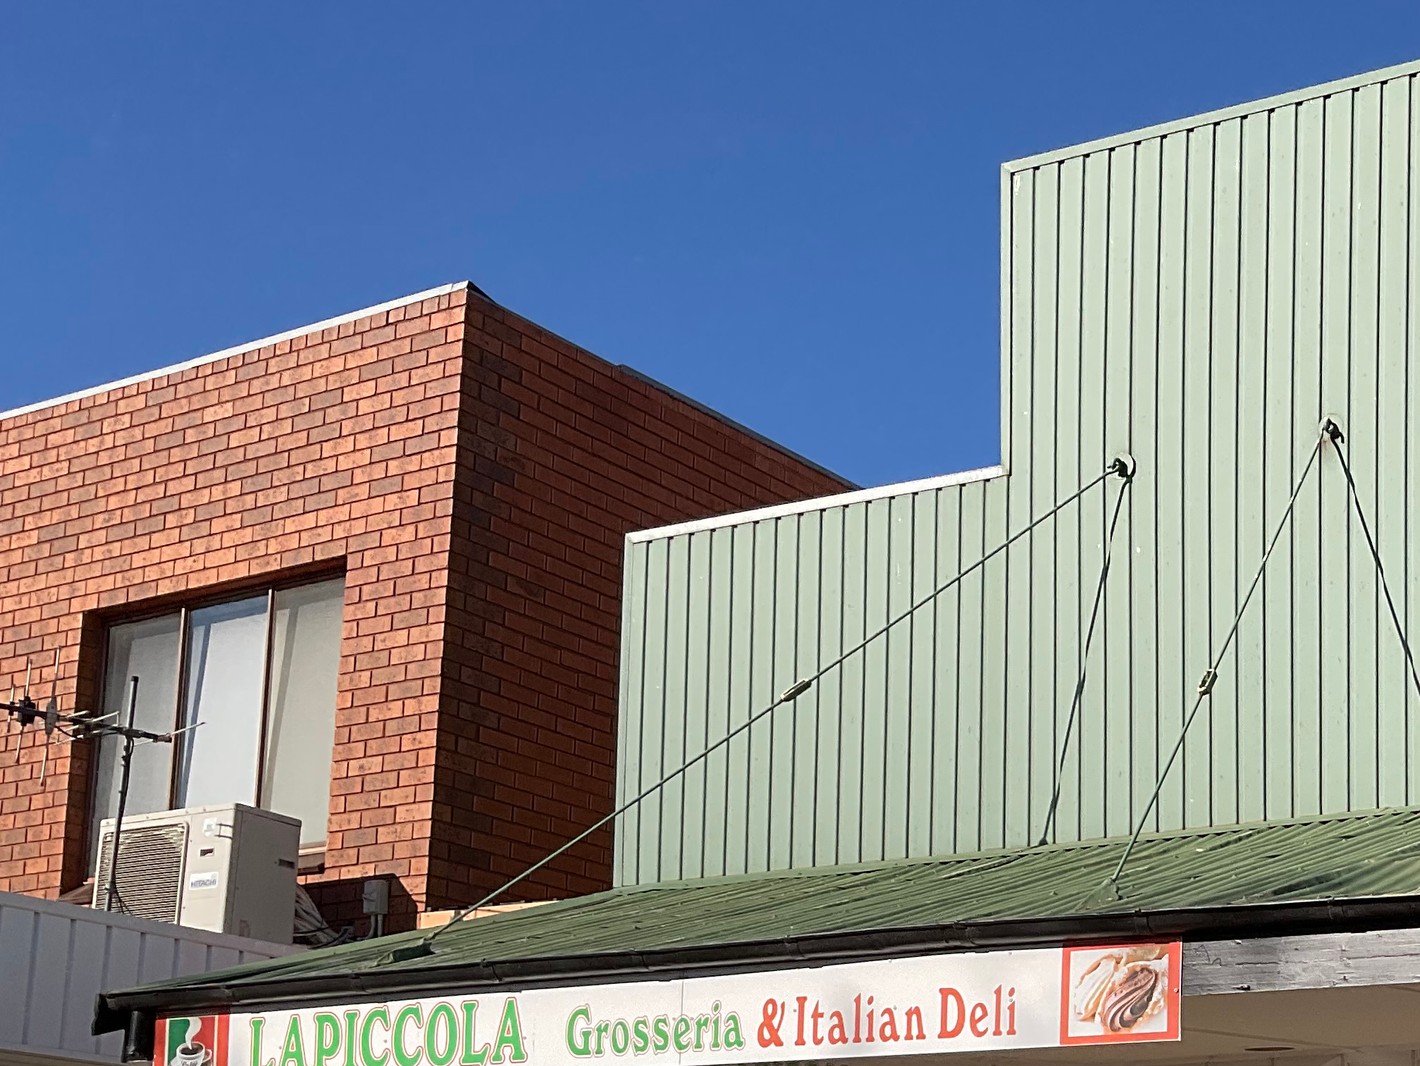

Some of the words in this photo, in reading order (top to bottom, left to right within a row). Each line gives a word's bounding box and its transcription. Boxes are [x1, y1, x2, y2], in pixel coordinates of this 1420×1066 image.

[190, 878, 217, 888] HITACHI
[565, 1000, 746, 1058] Grosseria
[937, 984, 1017, 1039] Deli
